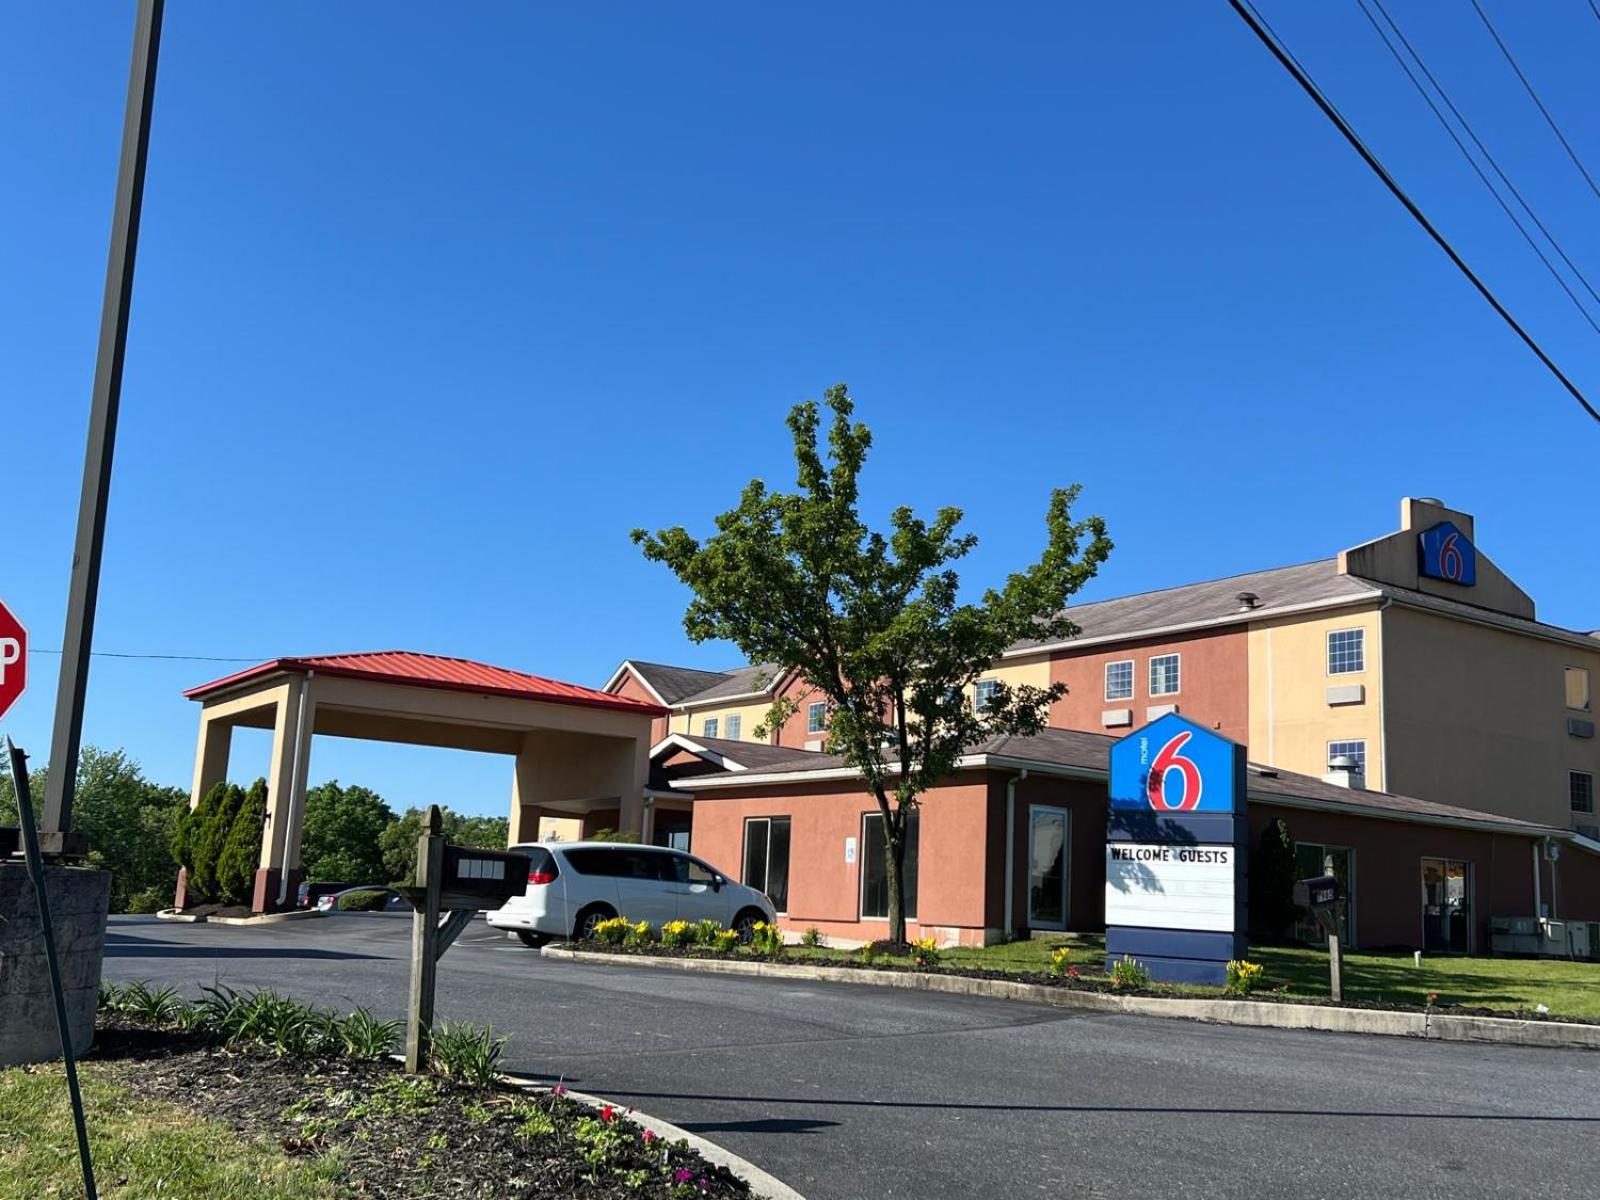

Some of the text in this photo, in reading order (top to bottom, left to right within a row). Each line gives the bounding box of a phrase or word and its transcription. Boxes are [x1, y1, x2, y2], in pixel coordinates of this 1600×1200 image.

[1440, 532, 1463, 582] 6
[1140, 731, 1202, 811] motel 6
[1111, 847, 1228, 864] WELCOME GUESTS
